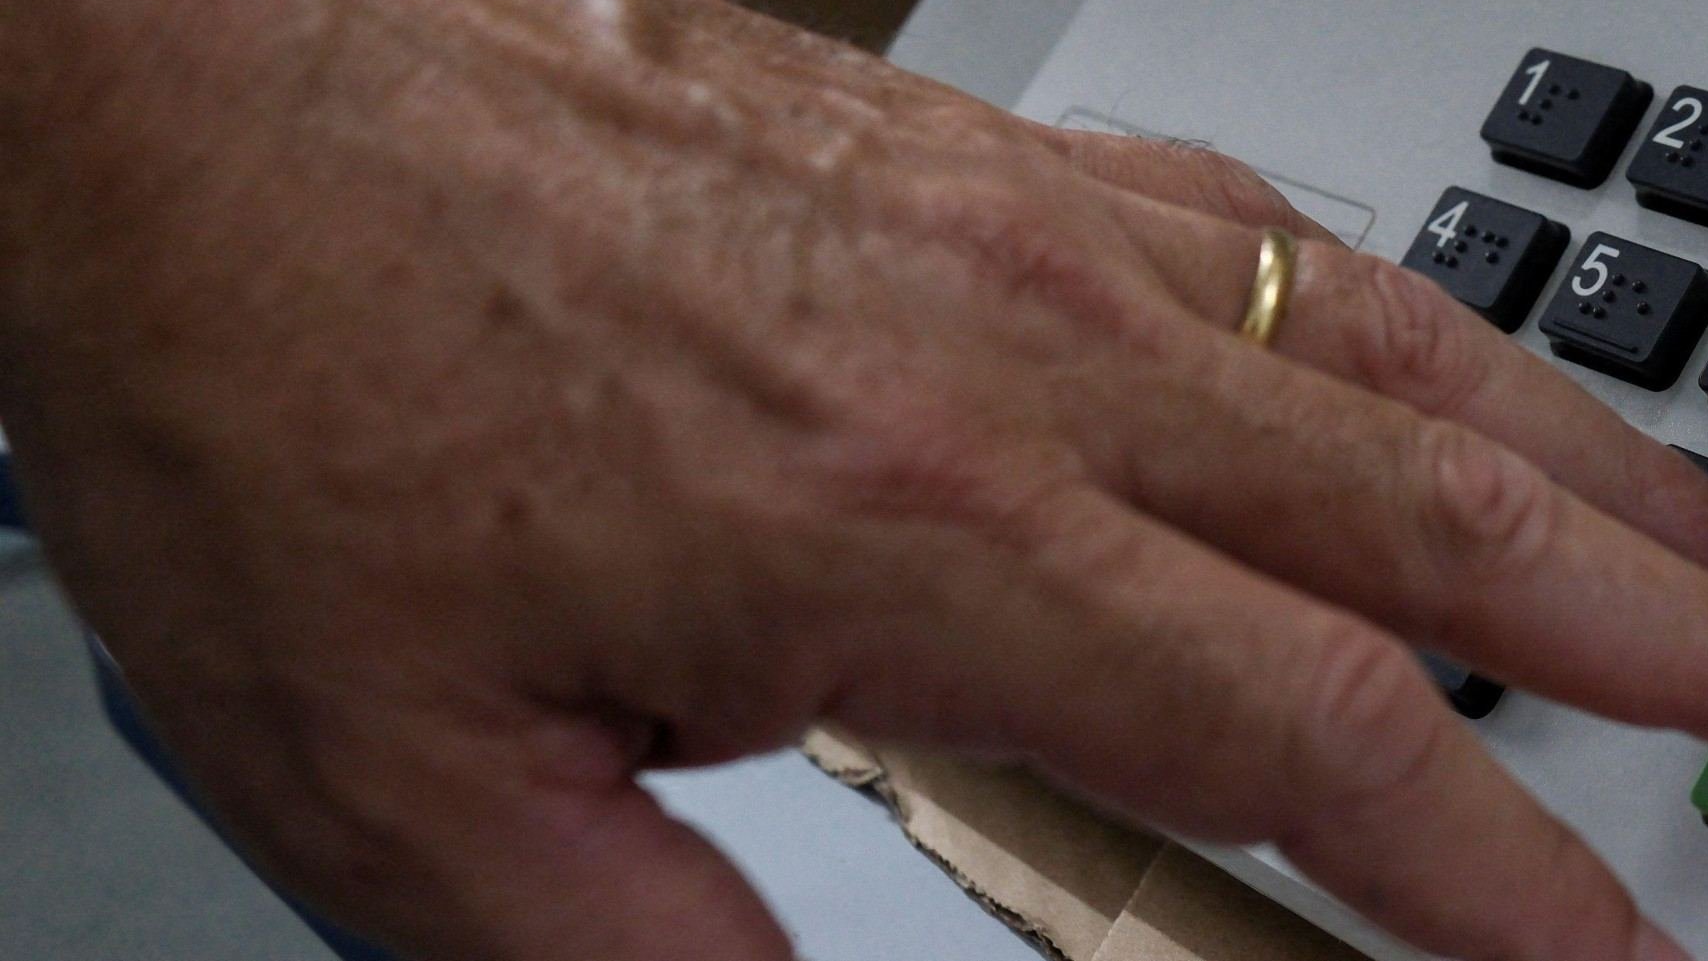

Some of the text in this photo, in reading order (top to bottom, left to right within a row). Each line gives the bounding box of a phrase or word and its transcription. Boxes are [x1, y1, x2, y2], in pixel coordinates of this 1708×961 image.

[1517, 60, 1550, 105] 1
[1653, 96, 1704, 149] 2
[1428, 200, 1469, 247] 4
[1572, 246, 1620, 298] 5
